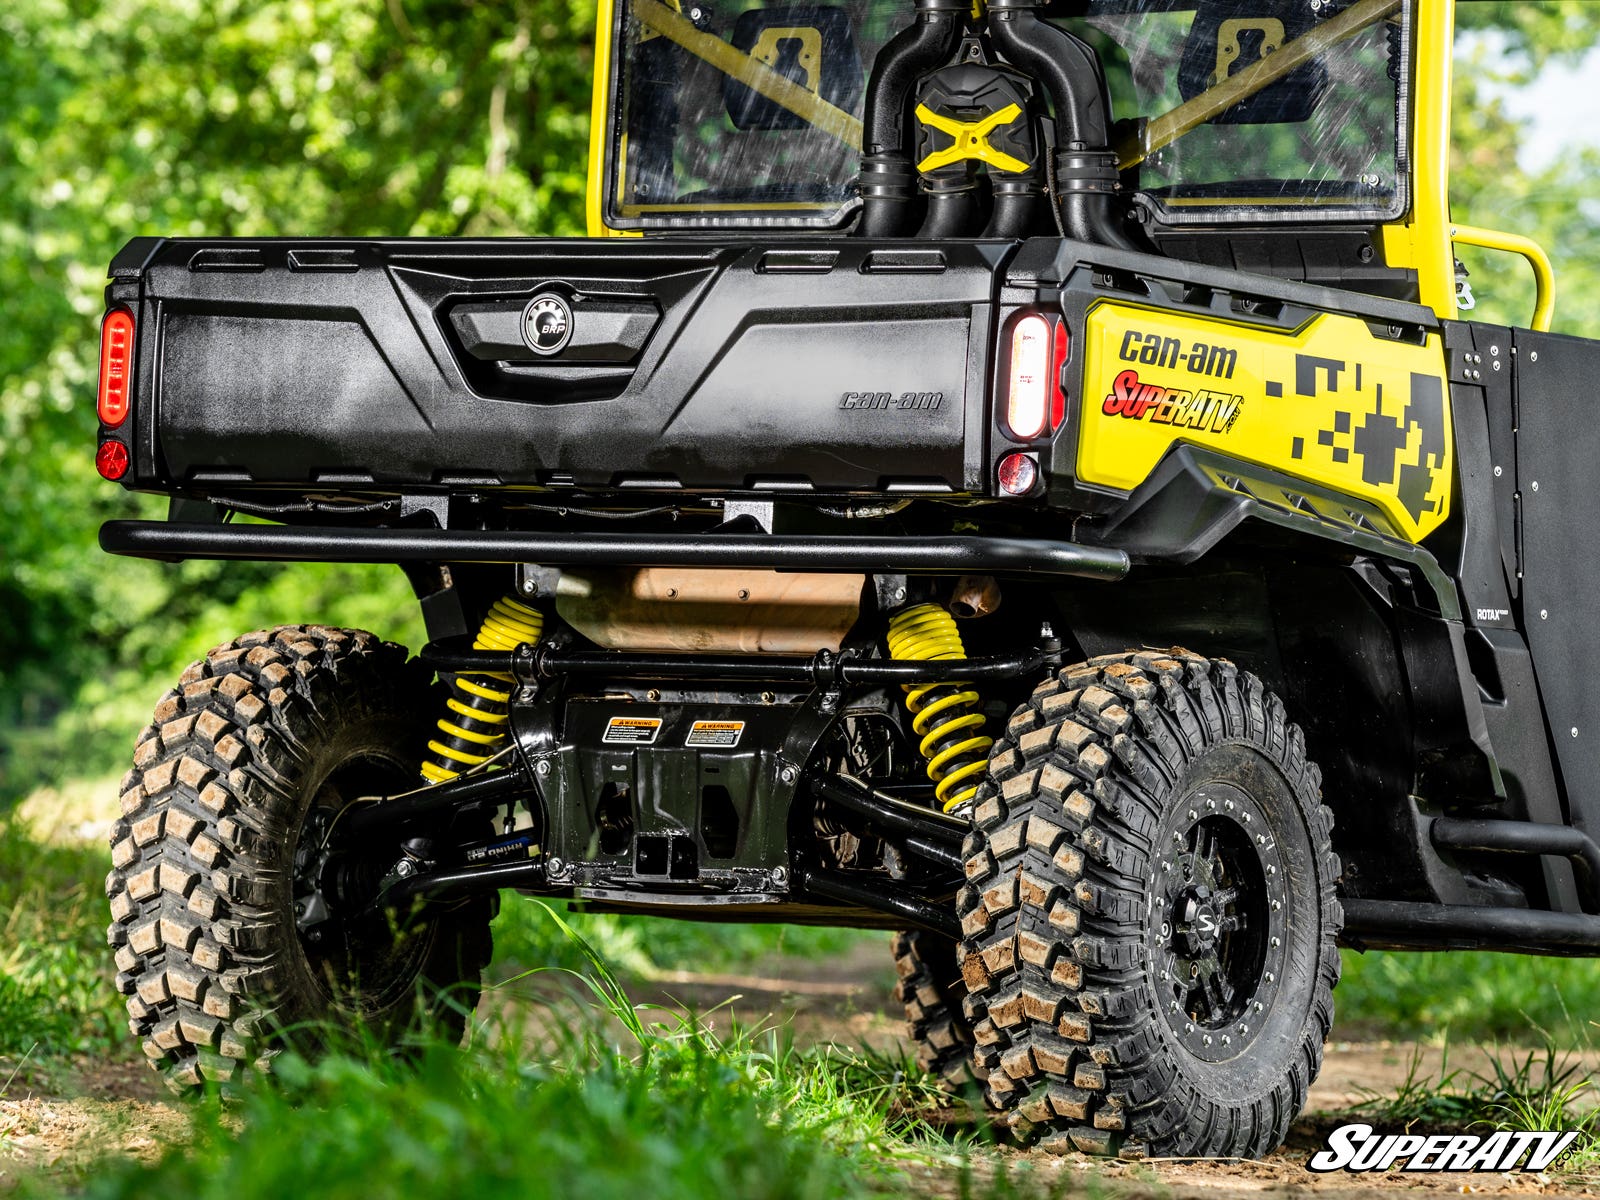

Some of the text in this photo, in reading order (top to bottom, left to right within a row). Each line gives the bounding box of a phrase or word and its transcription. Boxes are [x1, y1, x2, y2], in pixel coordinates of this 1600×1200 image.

[541, 325, 565, 334] BRP
[1119, 330, 1237, 379] can-am
[839, 391, 943, 410] can-am
[1102, 369, 1243, 434] SUPERATV
[1476, 608, 1500, 621] ROTAX
